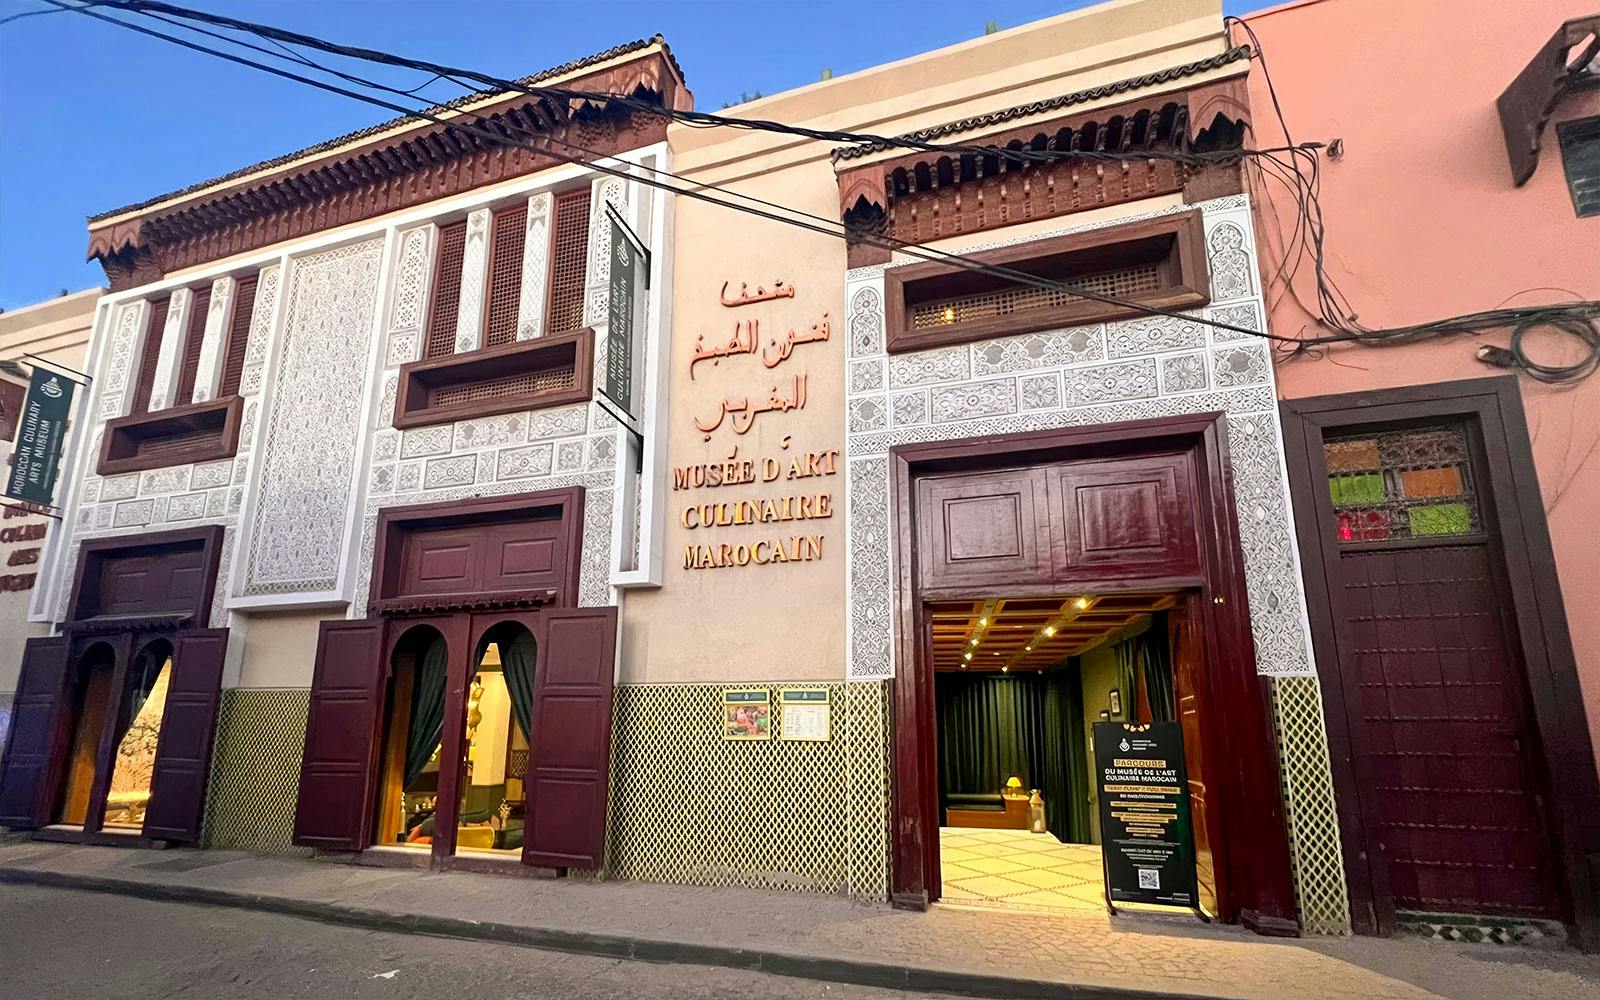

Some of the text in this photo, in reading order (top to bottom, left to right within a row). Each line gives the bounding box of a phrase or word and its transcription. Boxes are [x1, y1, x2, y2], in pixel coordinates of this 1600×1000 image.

[619, 276, 627, 338] MAROCAIN
[719, 279, 795, 308] متحف
[611, 316, 618, 335] DE
[689, 319, 759, 381] الطبخ
[762, 311, 830, 368] فنون
[610, 339, 618, 381] MUSÉE
[694, 373, 808, 443] المغربي
[12, 400, 42, 495] MOROCCAN CULINARY
[28, 420, 51, 484] ARTS MUSEUM
[673, 445, 756, 490] MUSÉE
[680, 492, 833, 530] CULINAIRE
[682, 534, 825, 570] MAROCAIN
